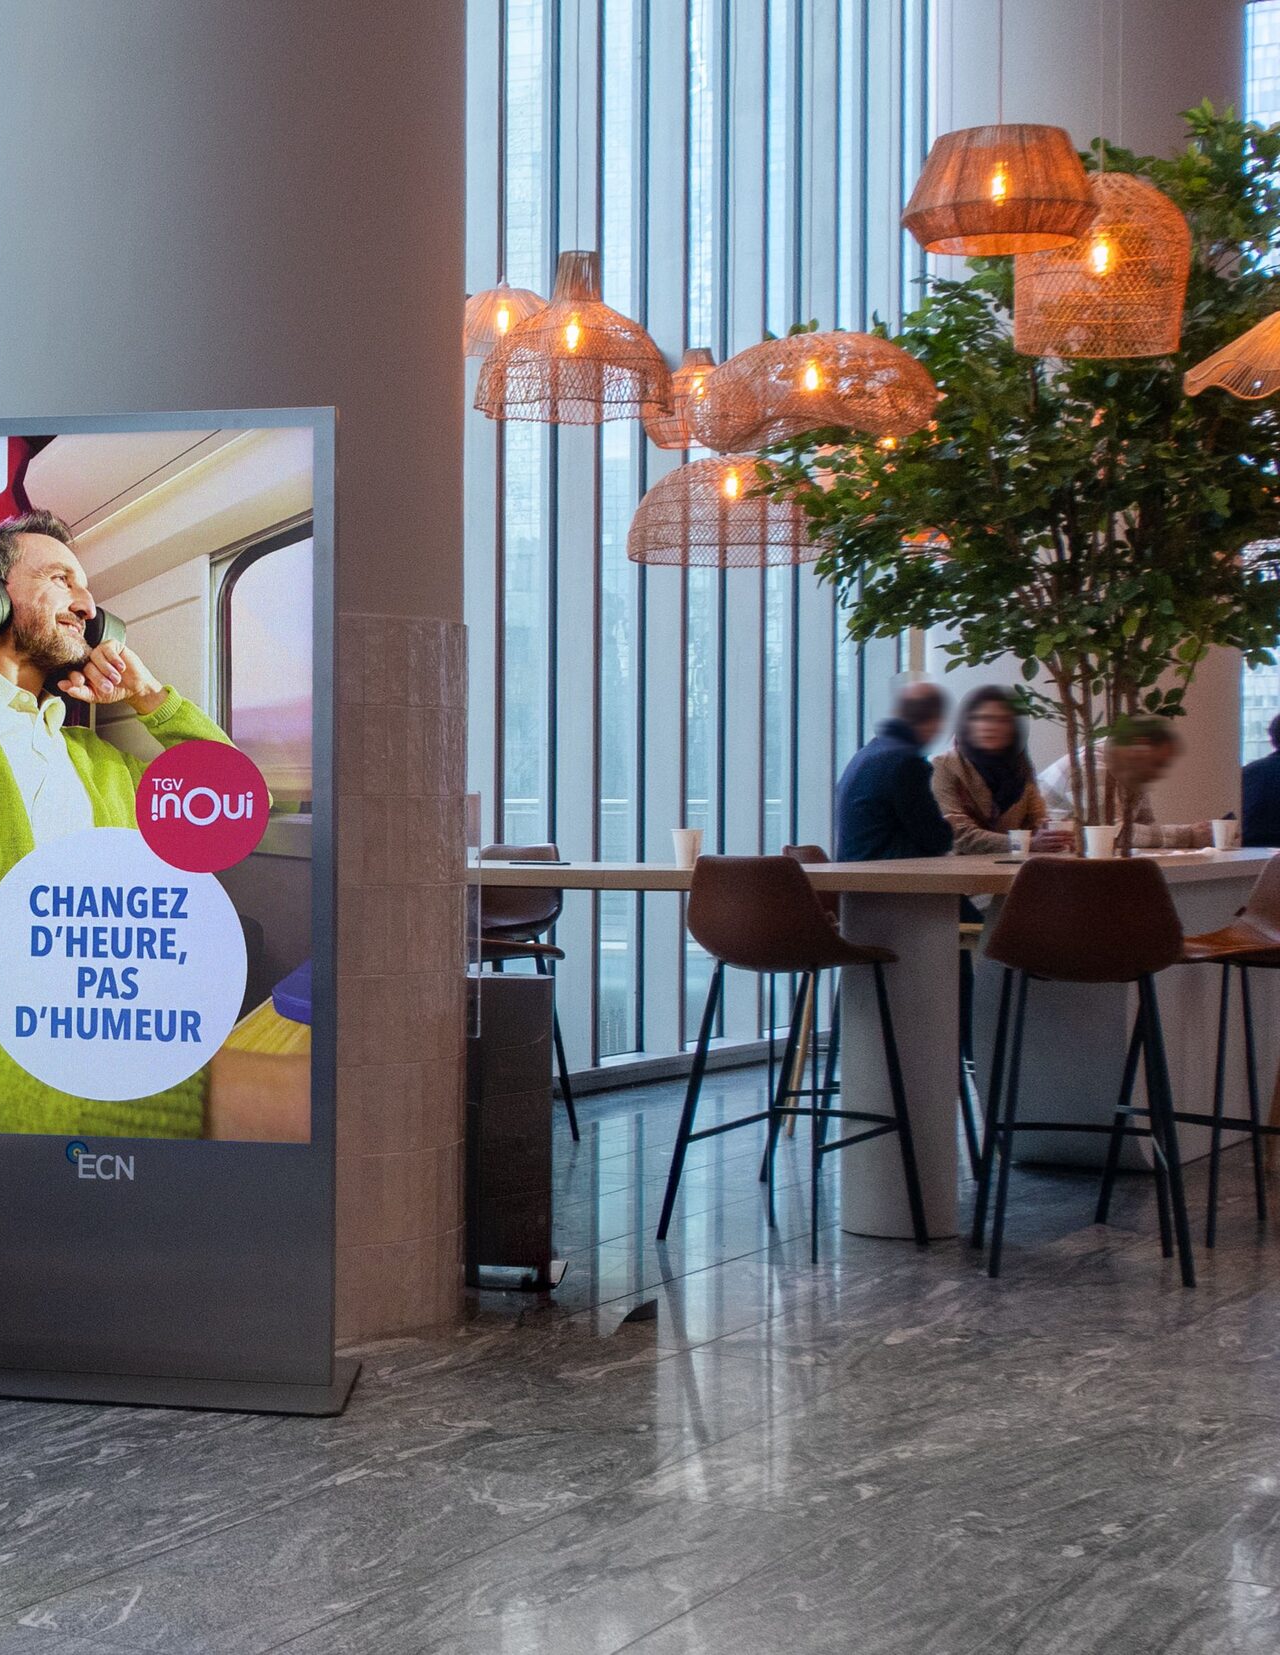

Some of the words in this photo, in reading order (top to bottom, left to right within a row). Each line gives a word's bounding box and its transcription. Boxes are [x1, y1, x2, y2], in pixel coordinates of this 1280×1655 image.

[152, 778, 183, 791] TGV
[29, 885, 188, 919] CHANGEZ
[30, 925, 187, 965] D'HEURE,
[77, 966, 139, 1000] PAS
[15, 1006, 202, 1043] D'HUMEUR
[78, 1153, 135, 1180] ECN
